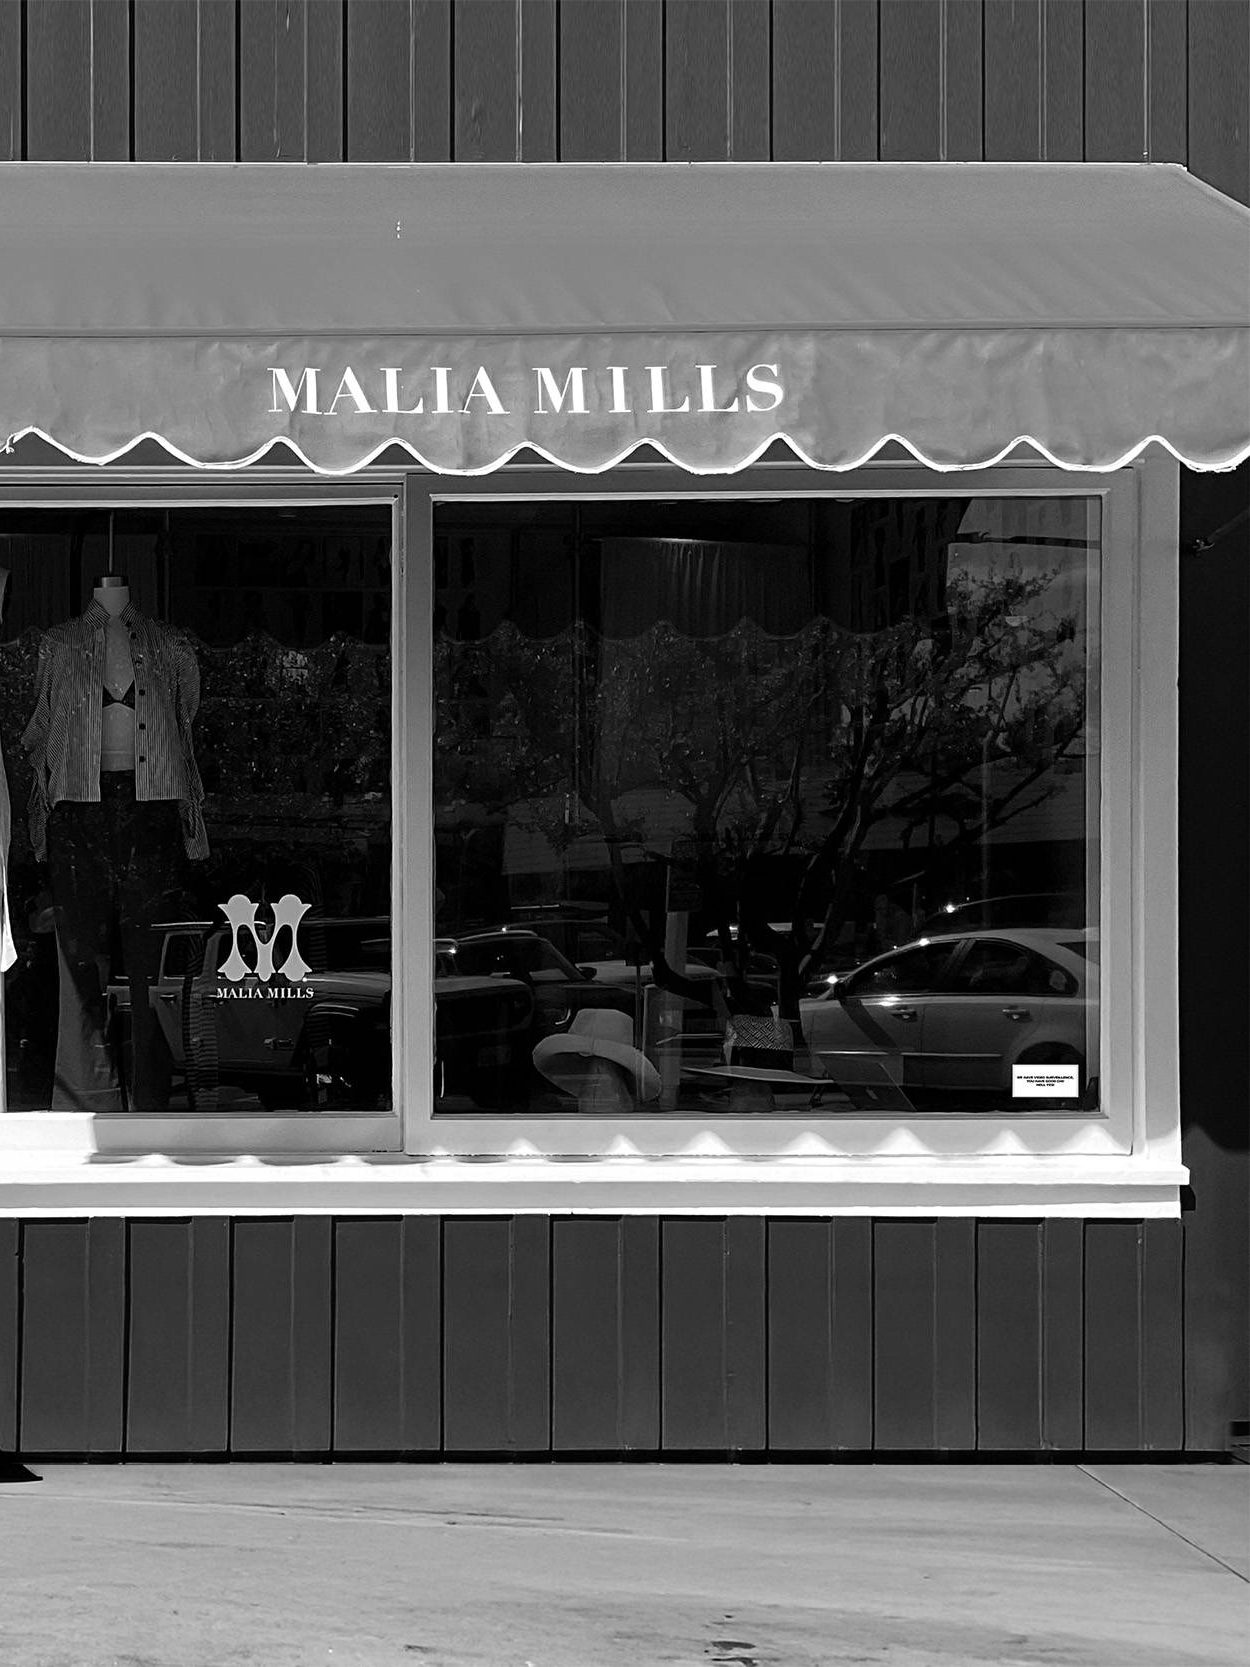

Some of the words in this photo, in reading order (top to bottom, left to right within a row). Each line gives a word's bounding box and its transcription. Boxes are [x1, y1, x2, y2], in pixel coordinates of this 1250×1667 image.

[267, 366, 510, 415] MALIA
[532, 364, 784, 414] MILLS
[216, 987, 263, 999] MALIA
[267, 987, 315, 999] MILLS
